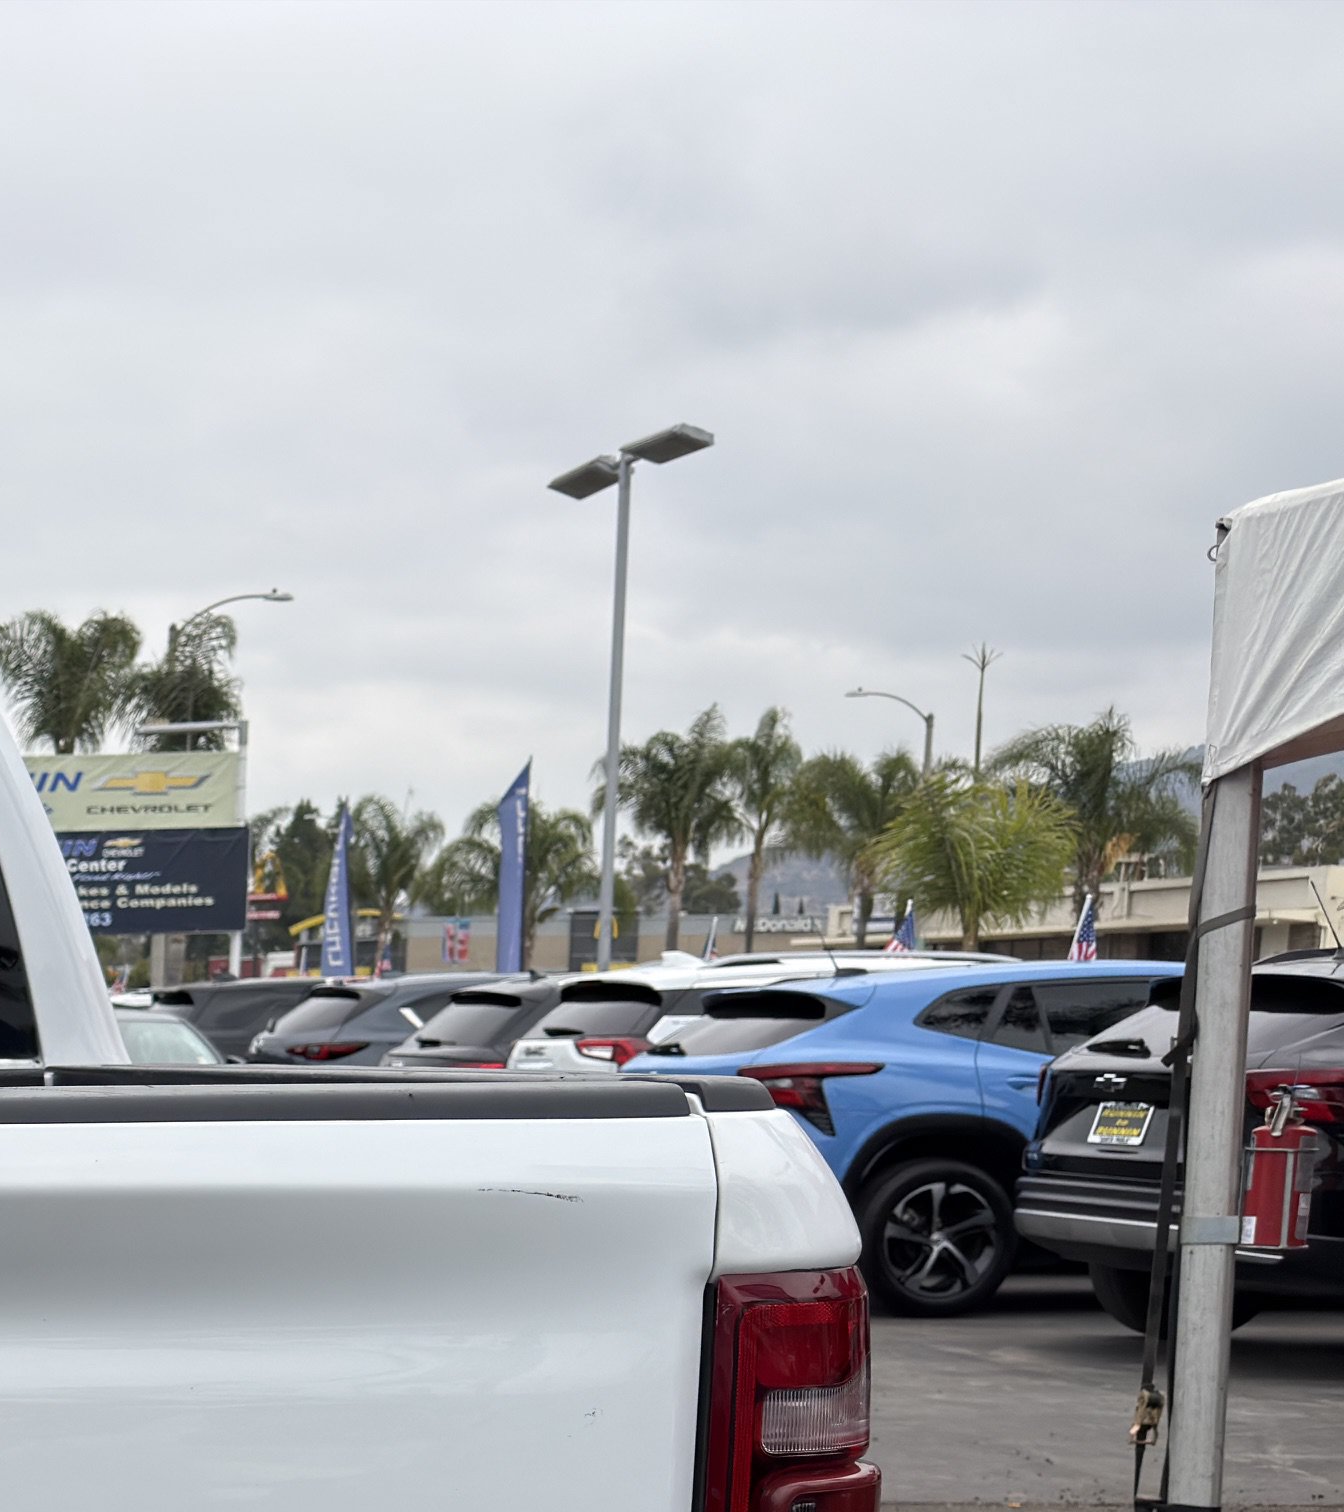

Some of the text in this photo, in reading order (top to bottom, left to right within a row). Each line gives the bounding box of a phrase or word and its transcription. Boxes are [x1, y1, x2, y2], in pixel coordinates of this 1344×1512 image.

[86, 804, 216, 815] CHEVROLET
[66, 859, 127, 873] Center
[115, 884, 130, 896] &
[134, 882, 199, 896] Models
[116, 896, 215, 909] Companies
[84, 912, 112, 927] 63
